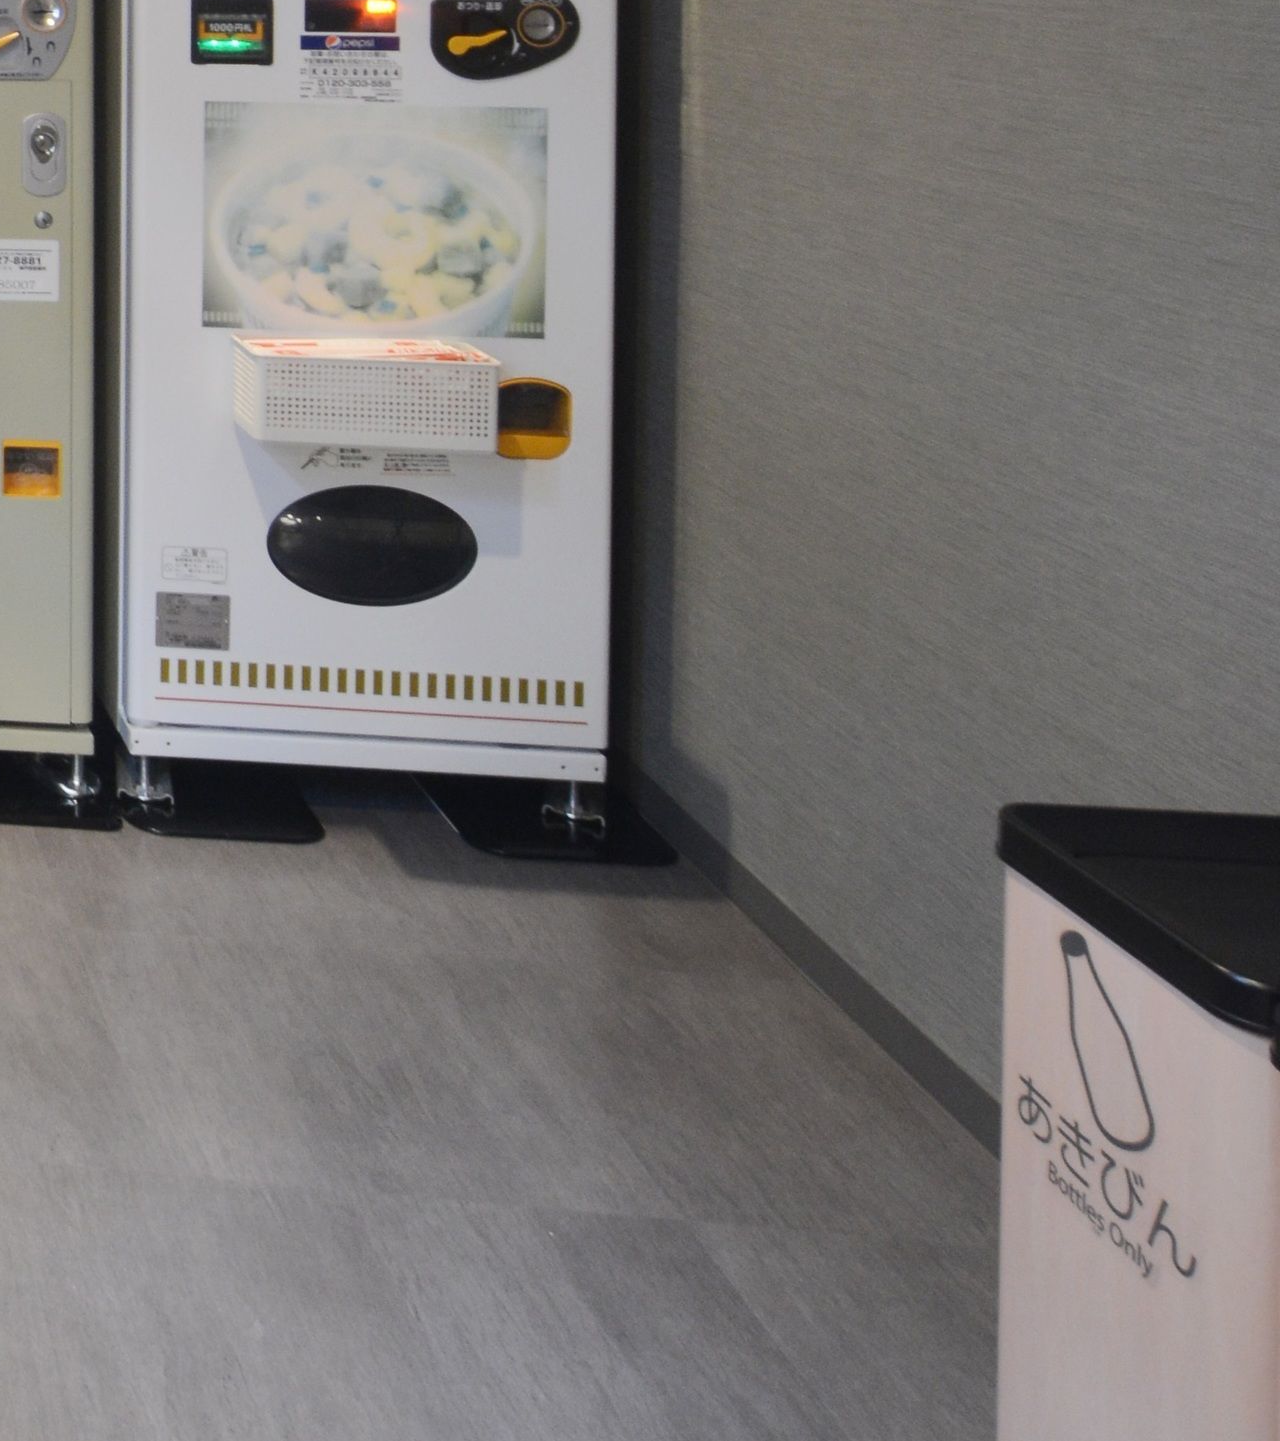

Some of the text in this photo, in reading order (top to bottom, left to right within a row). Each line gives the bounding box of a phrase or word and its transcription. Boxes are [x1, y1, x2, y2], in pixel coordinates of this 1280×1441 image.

[343, 39, 375, 49] pepsi
[1017, 1074, 1197, 1279] あきびん
[1047, 1161, 1154, 1279] Bottles Only
